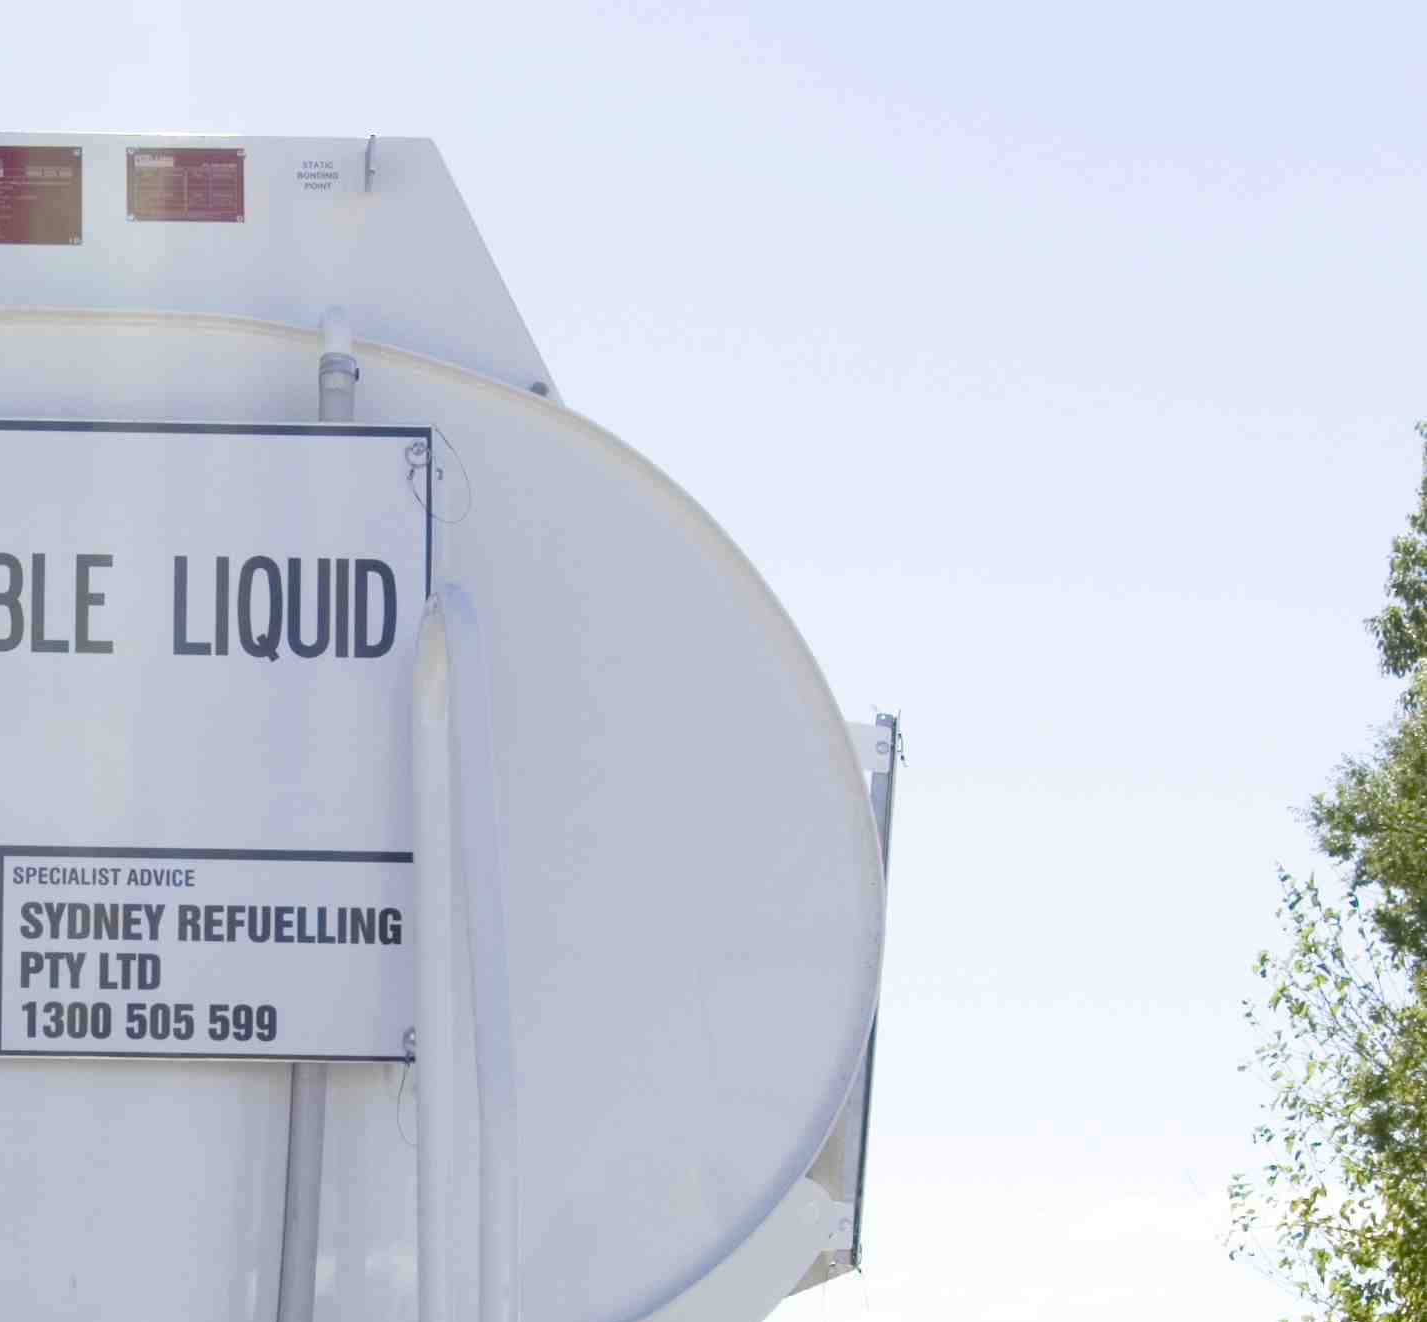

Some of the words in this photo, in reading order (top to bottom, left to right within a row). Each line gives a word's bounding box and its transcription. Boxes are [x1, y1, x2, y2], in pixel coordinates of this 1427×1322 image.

[296, 171, 340, 180] BONDING
[302, 160, 333, 169] STATIC
[303, 182, 332, 191] POINT
[174, 556, 398, 663] LIQUID
[12, 866, 122, 886] SPECIALIST
[126, 868, 195, 887] ADVICE
[19, 902, 166, 941] SYDNEY
[177, 904, 403, 946] REFUELLING
[20, 951, 86, 989] PTY
[99, 952, 161, 991] LTD
[21, 1001, 112, 1040] 1300
[125, 1002, 195, 1041] 505
[207, 1003, 278, 1042] 599
